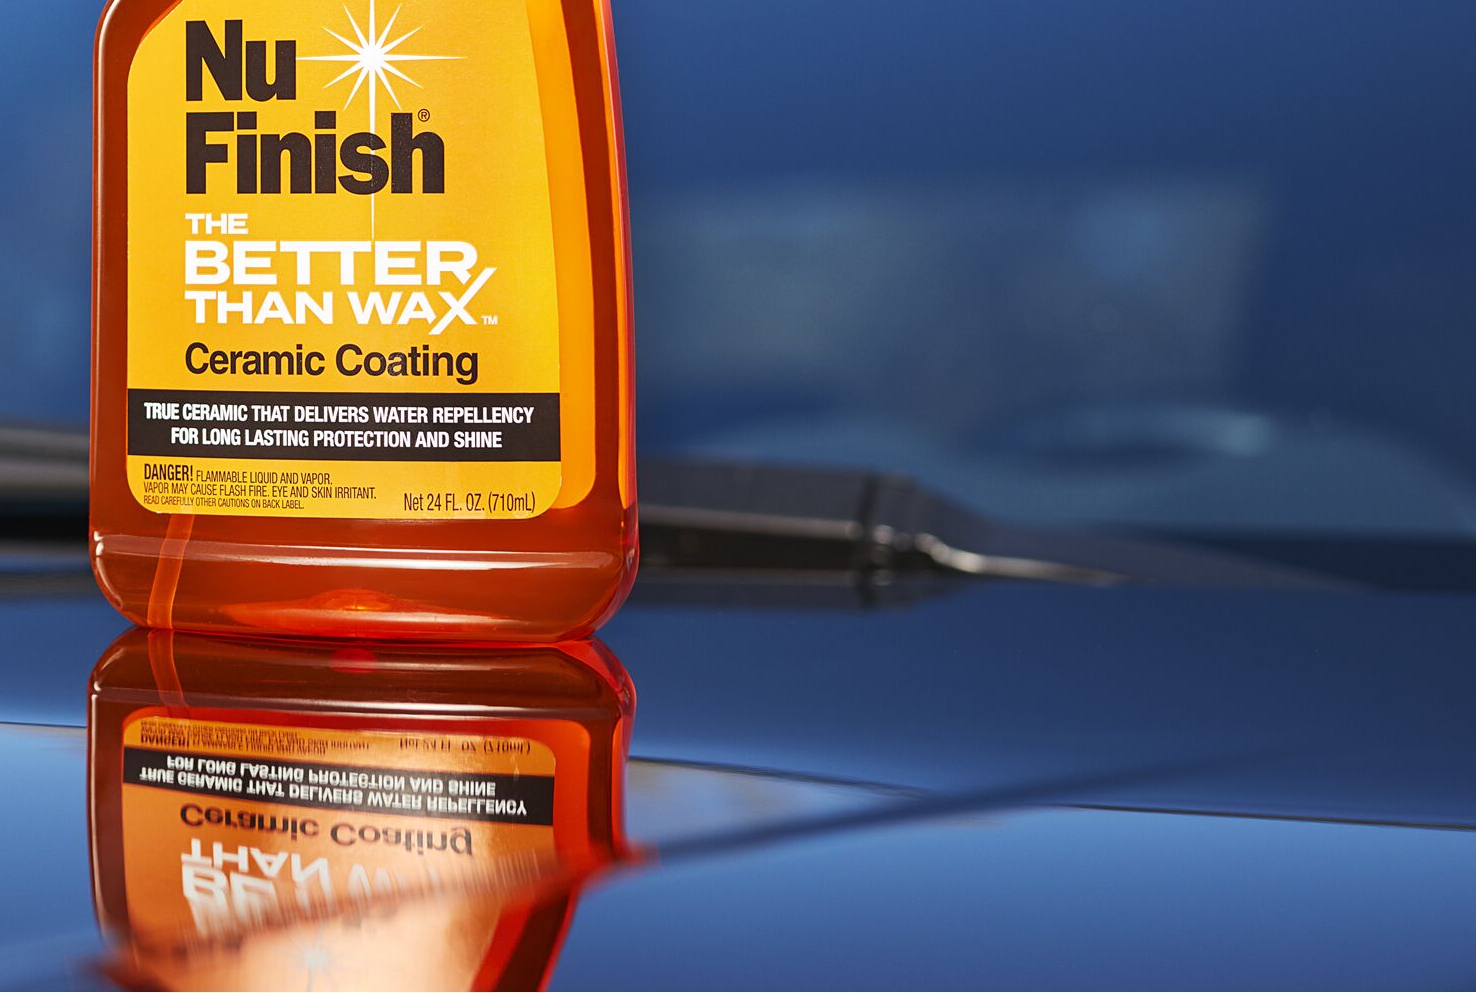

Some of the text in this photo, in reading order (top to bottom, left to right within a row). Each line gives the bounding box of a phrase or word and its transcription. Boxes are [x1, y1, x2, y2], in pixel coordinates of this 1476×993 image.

[185, 19, 297, 102] Nu
[185, 110, 445, 195] Finish
[185, 213, 249, 235] THE
[185, 240, 478, 286] BETTER
[184, 290, 333, 324] THAN
[346, 267, 498, 335] WAX
[185, 342, 478, 385] Ceramic Coating
[143, 402, 534, 424] TRUE CERAMIC THAT DELIVERS WATER REPELLENCY
[171, 427, 502, 448] FOR LONG LASTING PROTECTION AND SHINE
[144, 463, 333, 485] DANGER! FLAMMABLE LIQUID AND VAPOR.
[143, 482, 377, 500] VAPOR MAY CAUSE FLASH FIRE. EYE AND SKIN IRRITANT.
[404, 491, 536, 513] Net 24 FL. OZ. (710mL)
[143, 495, 305, 510] READ CAREFULLY OTHER CAUTIONS ON BACK LABEL.
